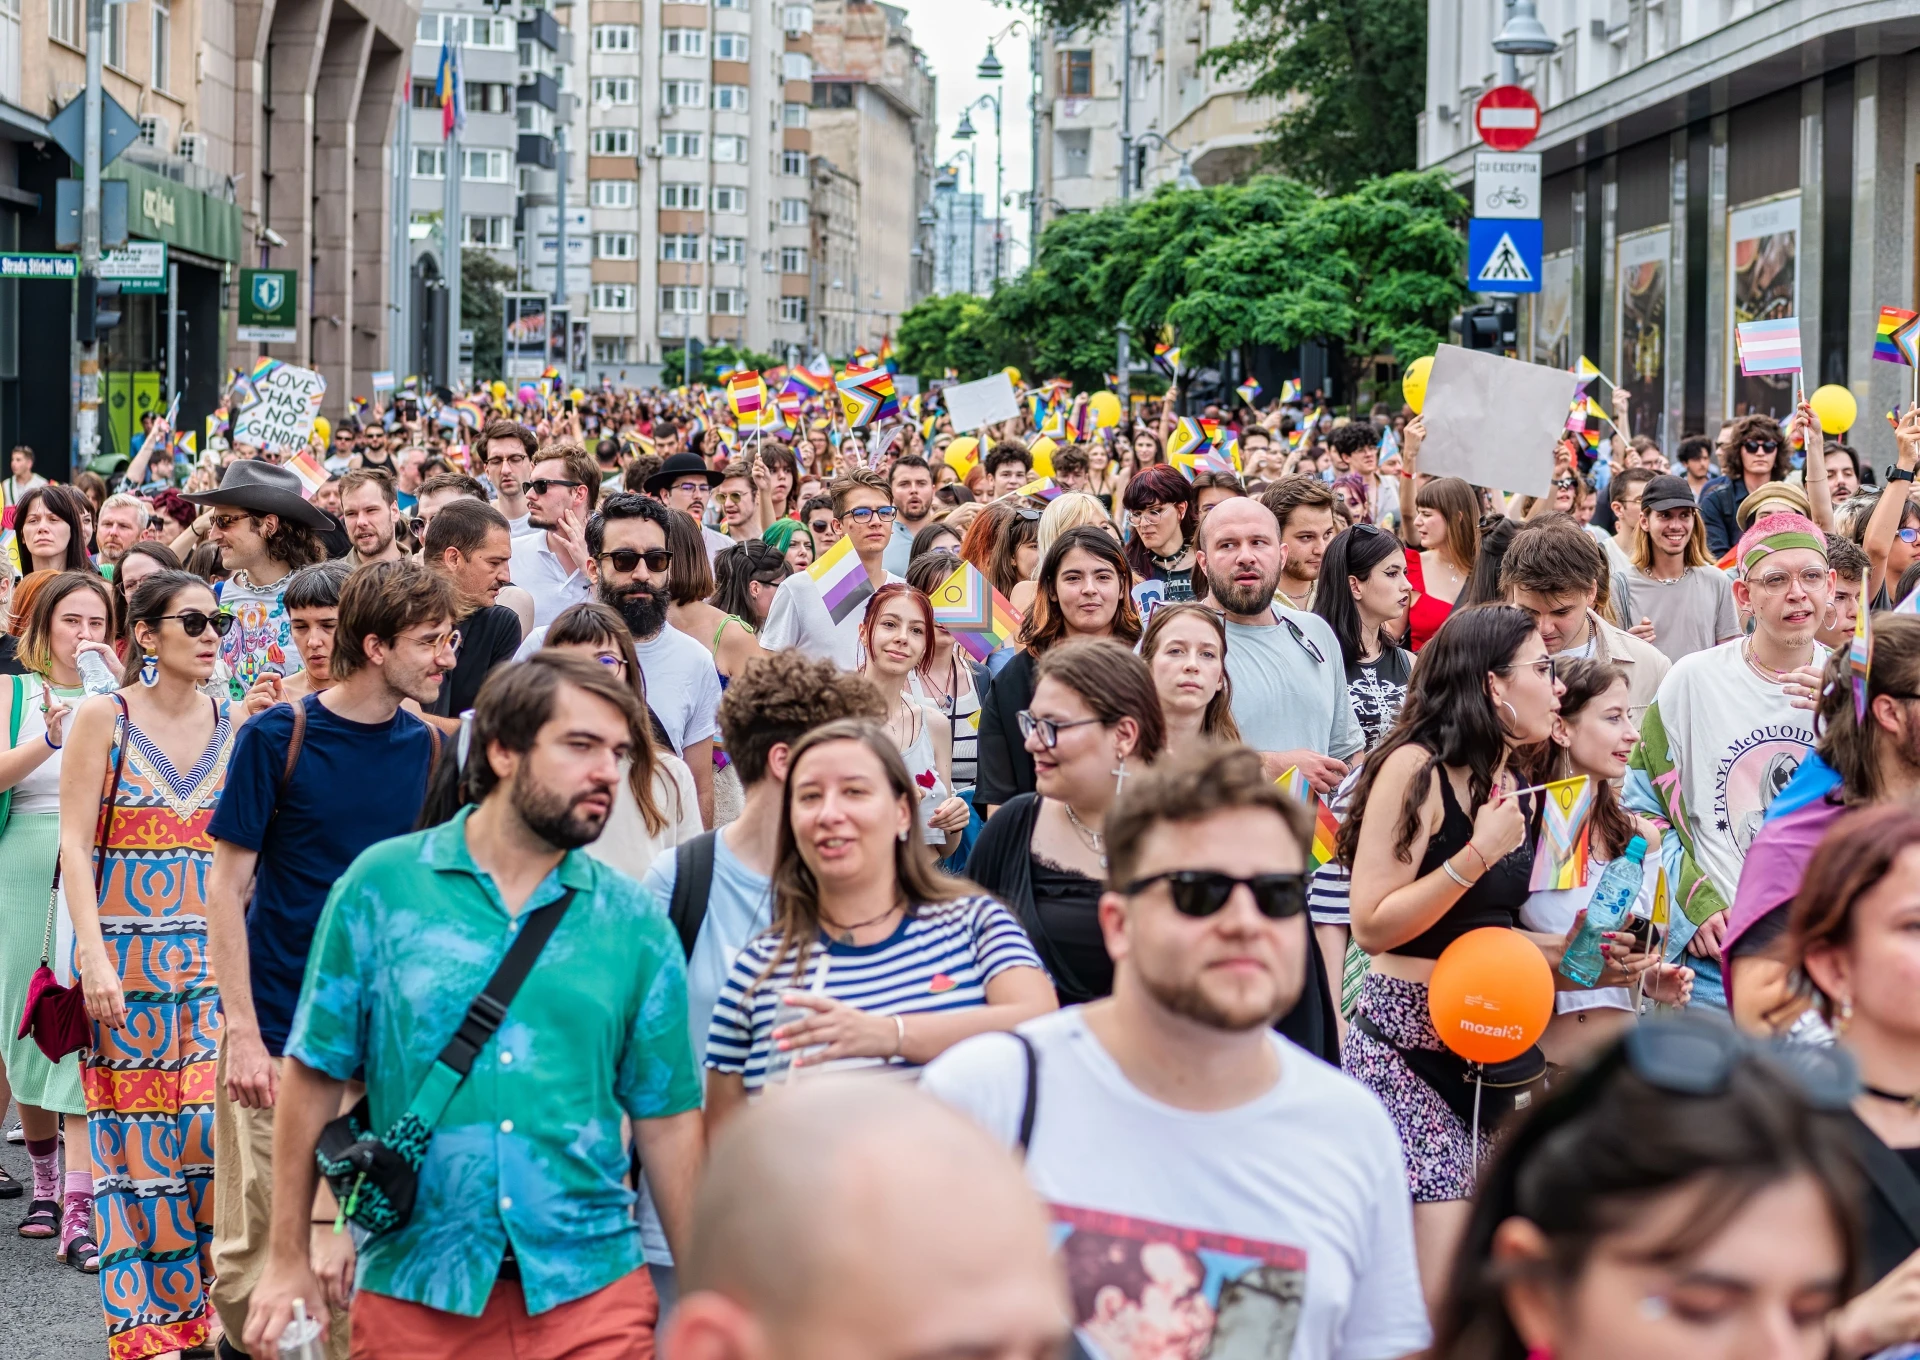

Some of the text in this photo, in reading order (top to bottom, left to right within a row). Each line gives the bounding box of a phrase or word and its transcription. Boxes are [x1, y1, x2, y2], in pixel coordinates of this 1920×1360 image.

[2, 257, 27, 274] Strada
[266, 368, 315, 395] LOVE
[267, 389, 306, 414] HAS
[265, 406, 297, 427] NO
[247, 419, 307, 452] GENDER
[1714, 725, 1814, 815] TANYA McQUOID
